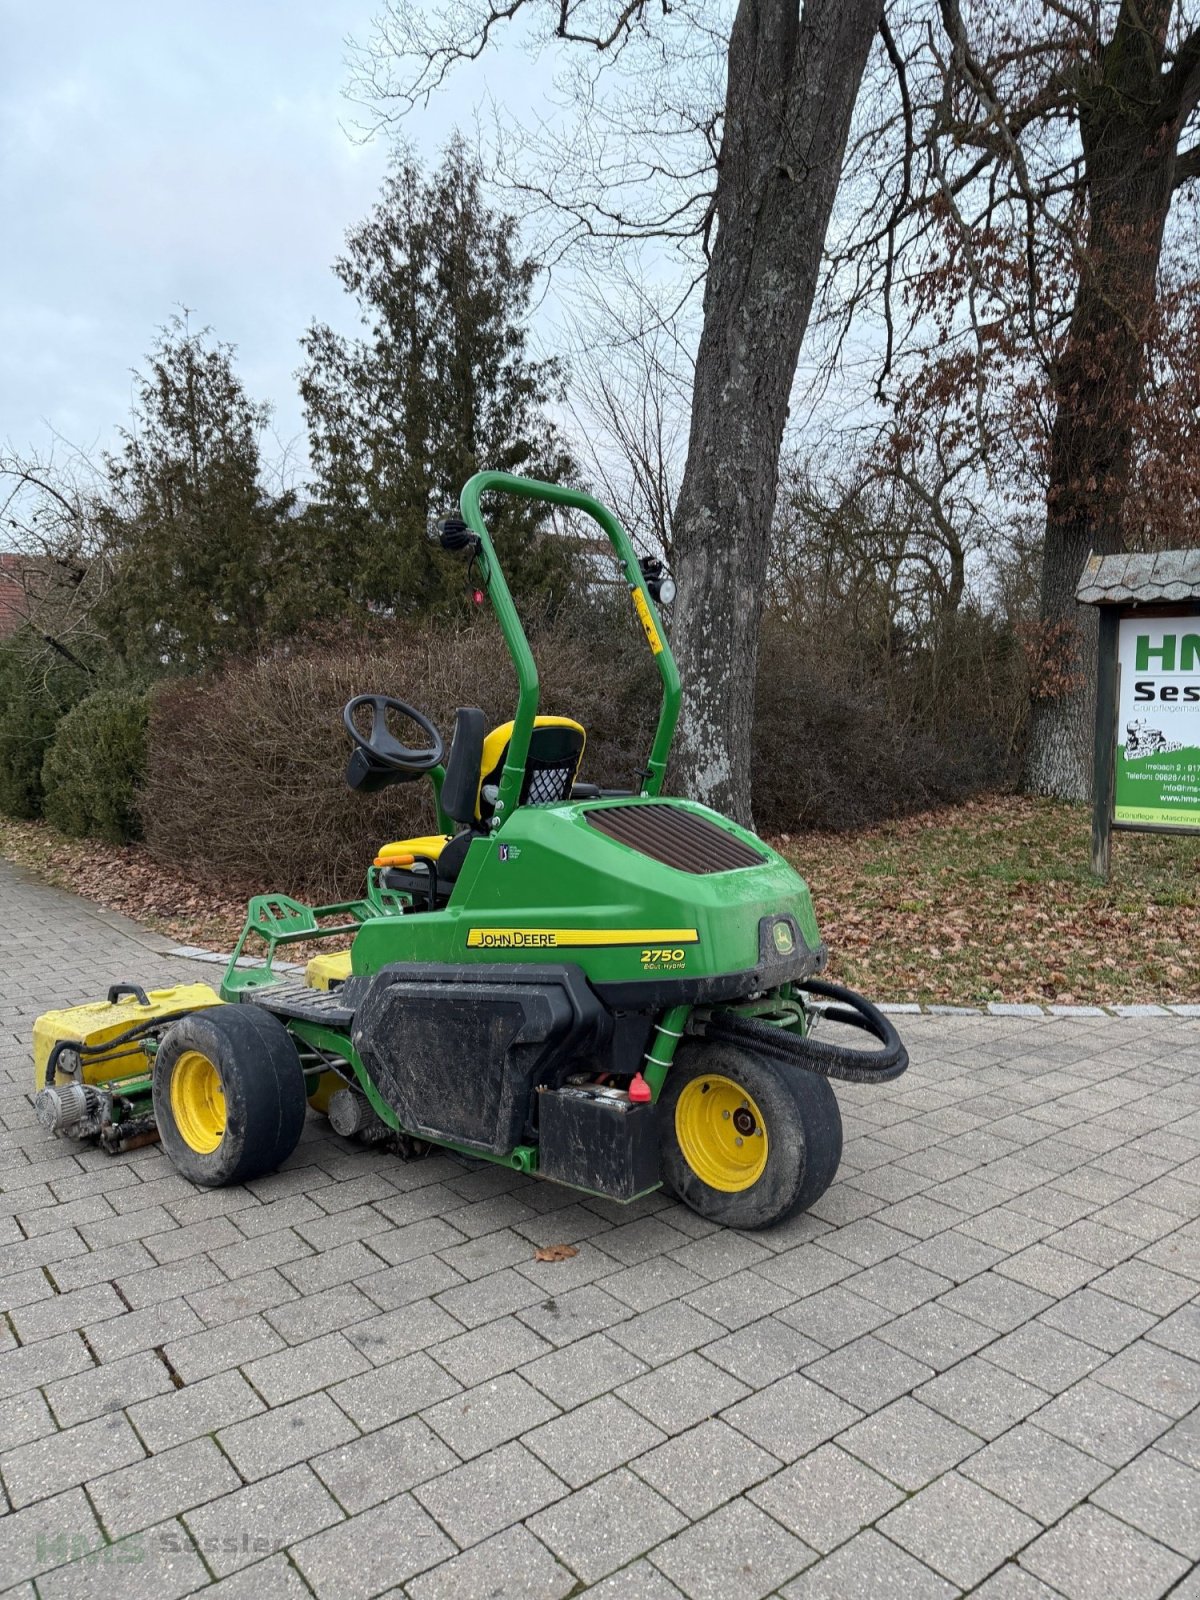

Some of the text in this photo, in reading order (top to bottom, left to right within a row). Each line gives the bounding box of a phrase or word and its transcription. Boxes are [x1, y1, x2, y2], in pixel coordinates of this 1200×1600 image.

[478, 932, 557, 946] JOHN DEERE
[640, 949, 685, 962] 2750
